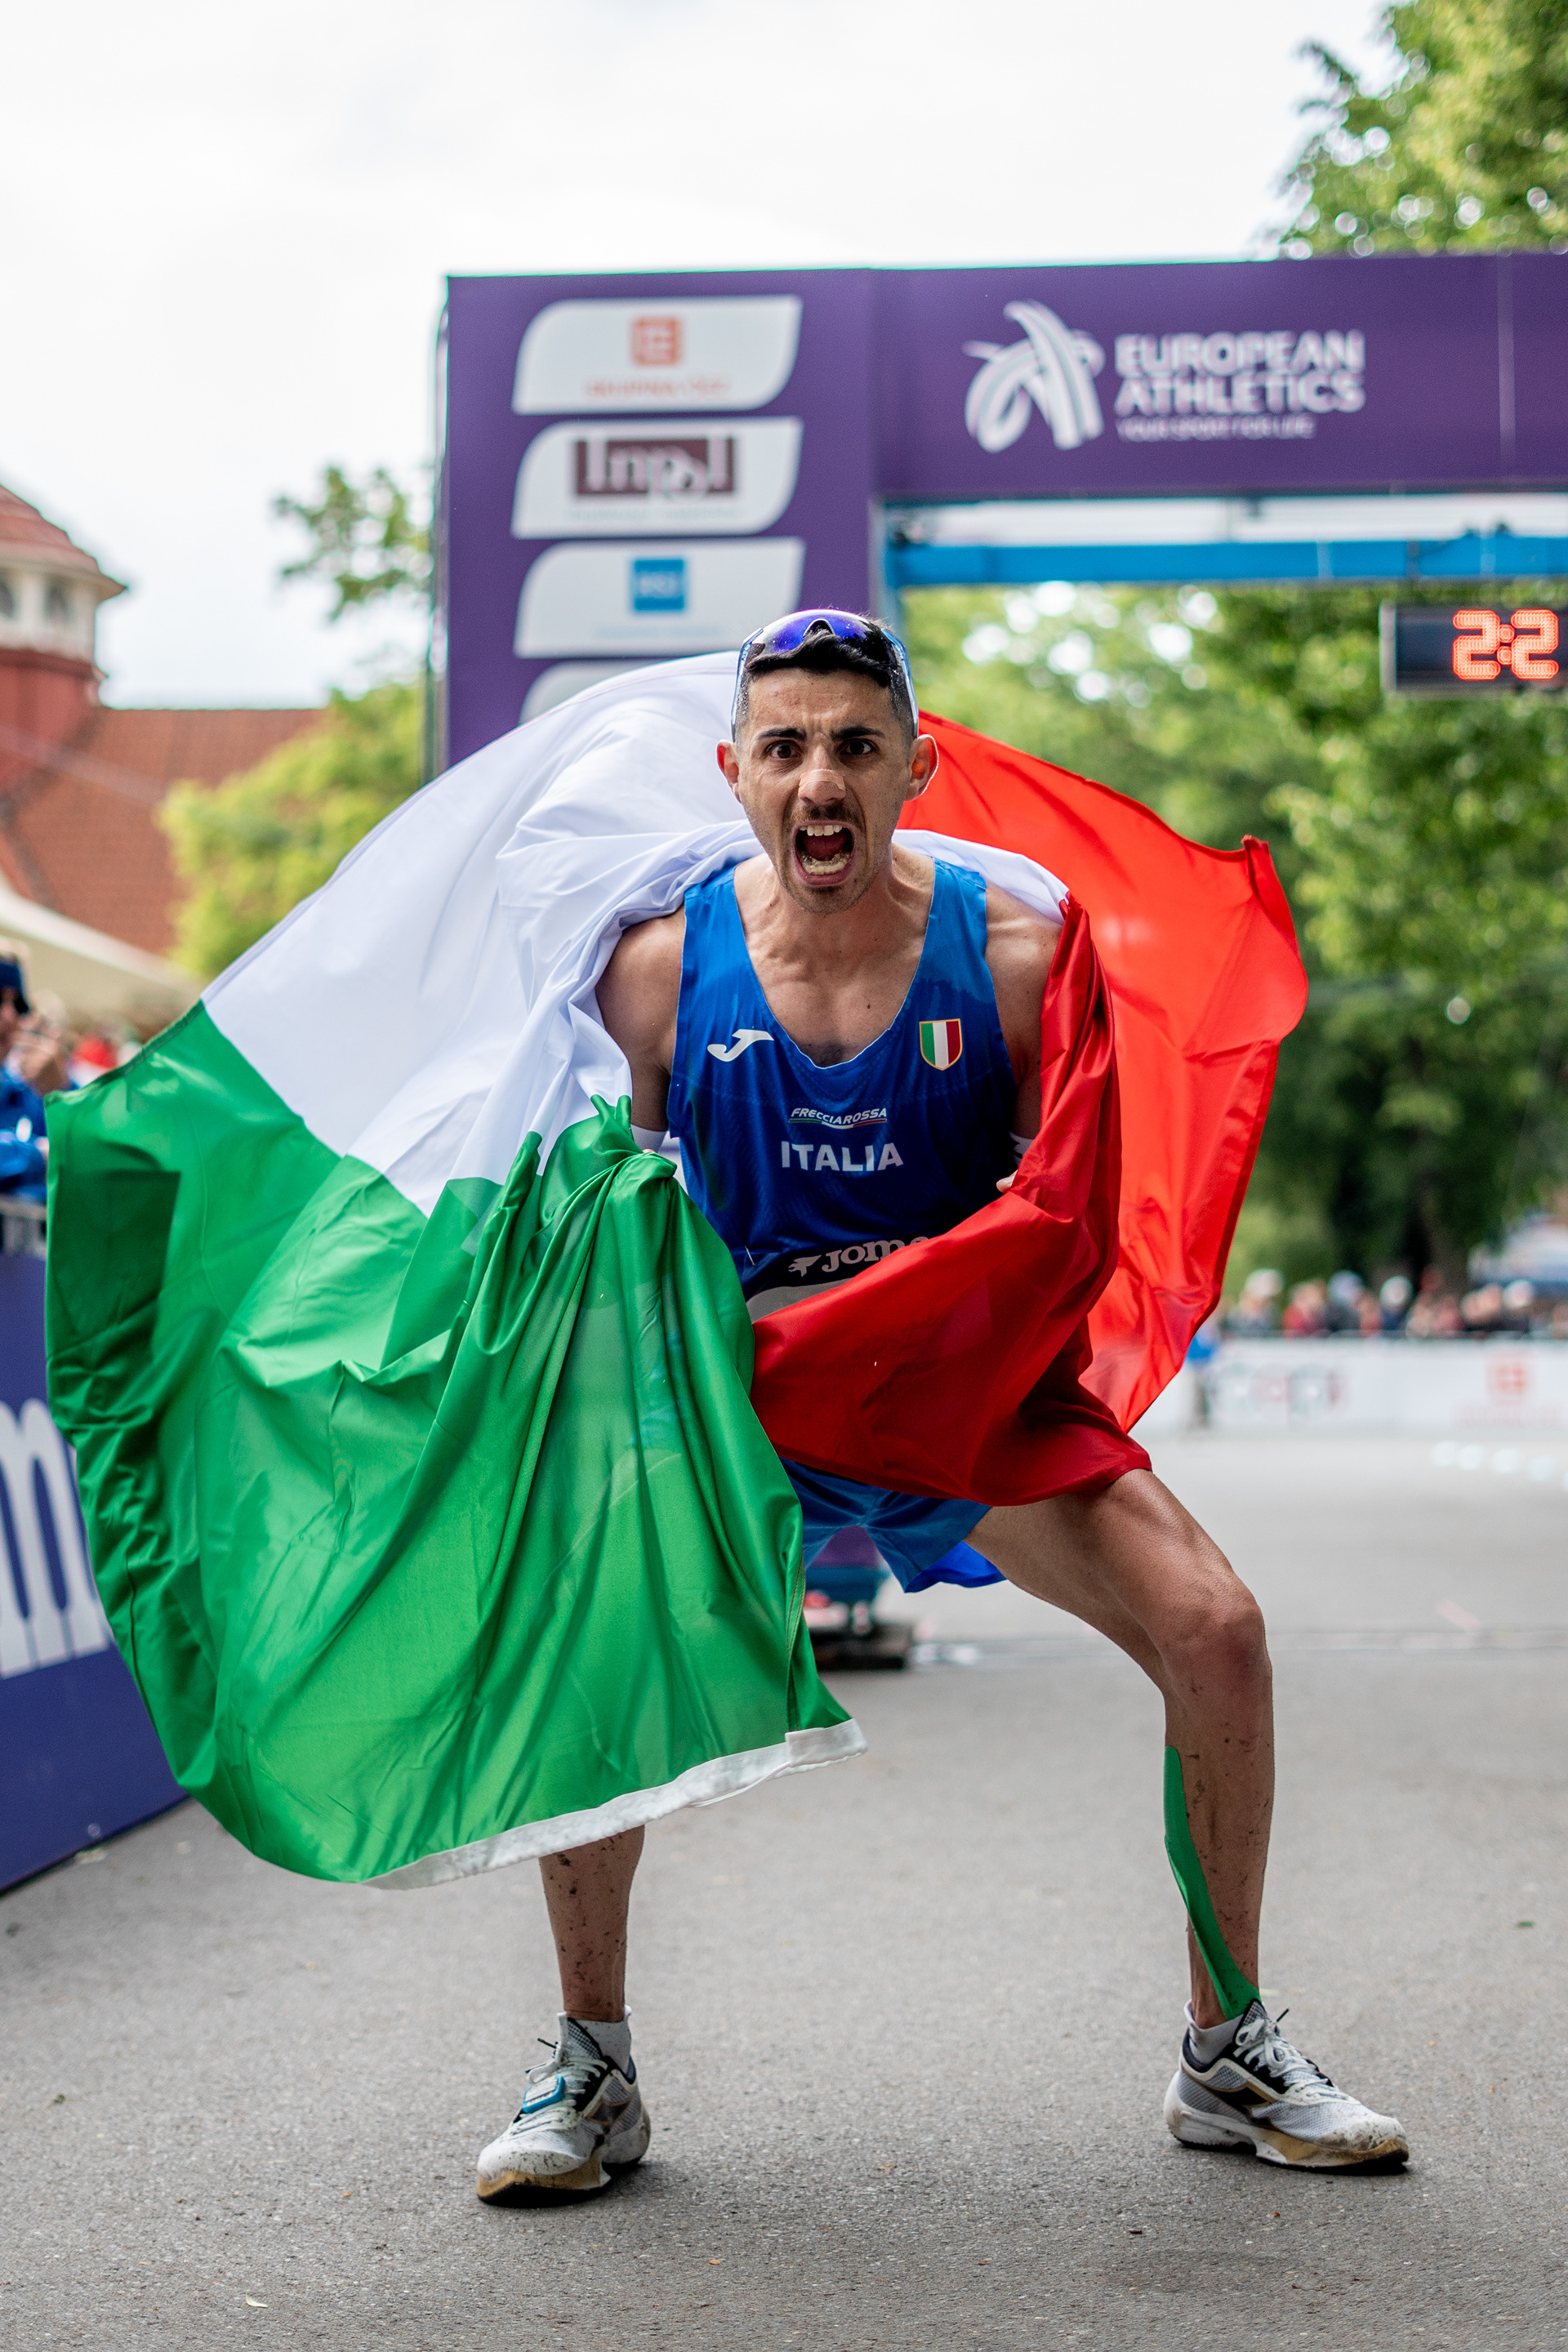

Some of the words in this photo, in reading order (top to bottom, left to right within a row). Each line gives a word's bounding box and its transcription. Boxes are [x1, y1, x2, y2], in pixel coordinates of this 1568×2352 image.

[1115, 330, 1365, 376] EUROPEAN
[1114, 372, 1365, 414] ATHLETICS
[791, 1107, 887, 1125] FRECCIAROSSA
[781, 1141, 904, 1171] ITALIA
[821, 1236, 929, 1272] Jom
